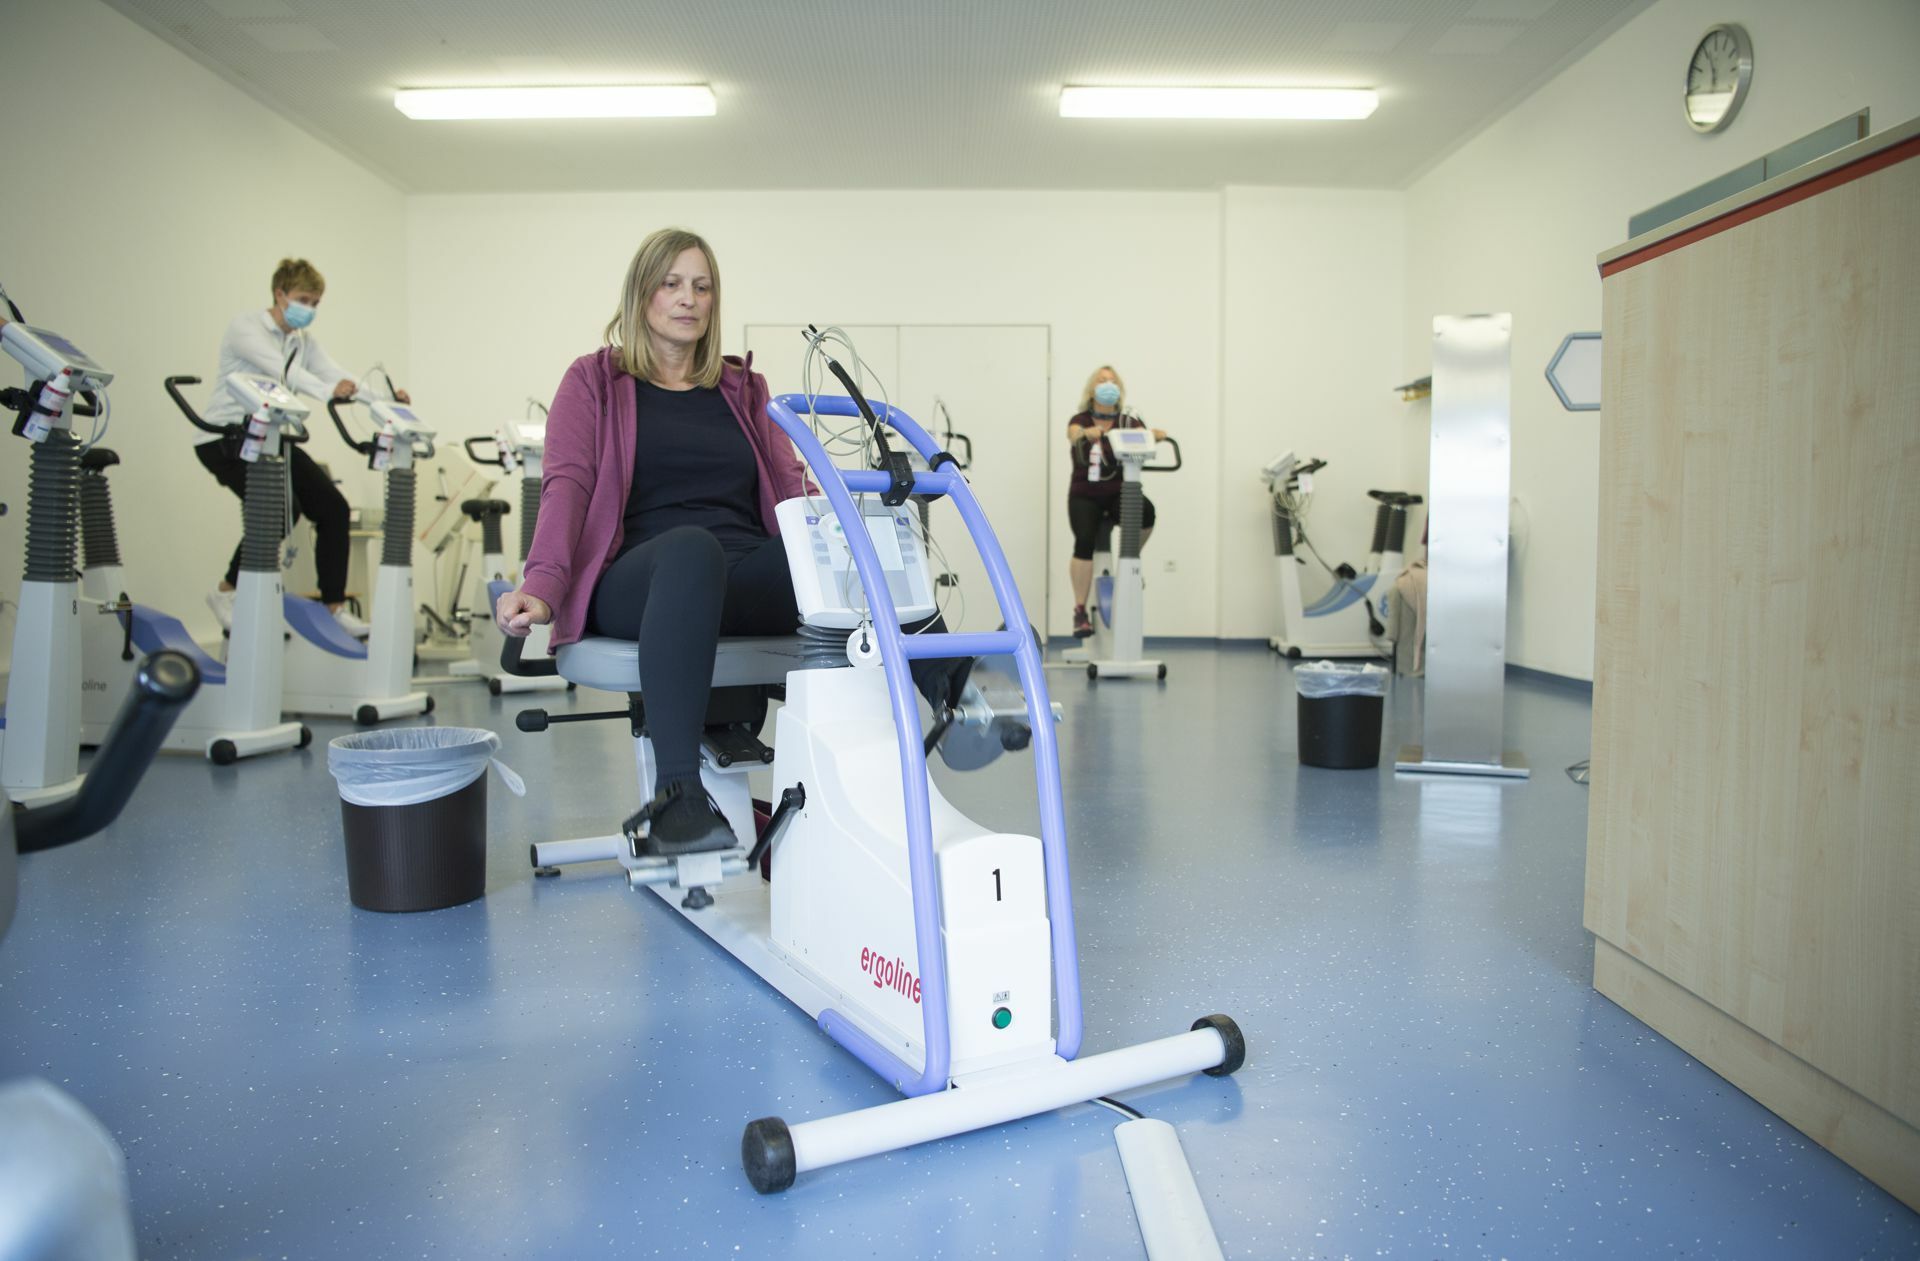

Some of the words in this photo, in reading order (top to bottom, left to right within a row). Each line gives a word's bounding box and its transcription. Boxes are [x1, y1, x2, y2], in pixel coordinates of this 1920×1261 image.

[72, 599, 78, 616] 8
[81, 679, 107, 692] oline
[992, 868, 1001, 901] 1
[861, 947, 921, 1004] ergoline
